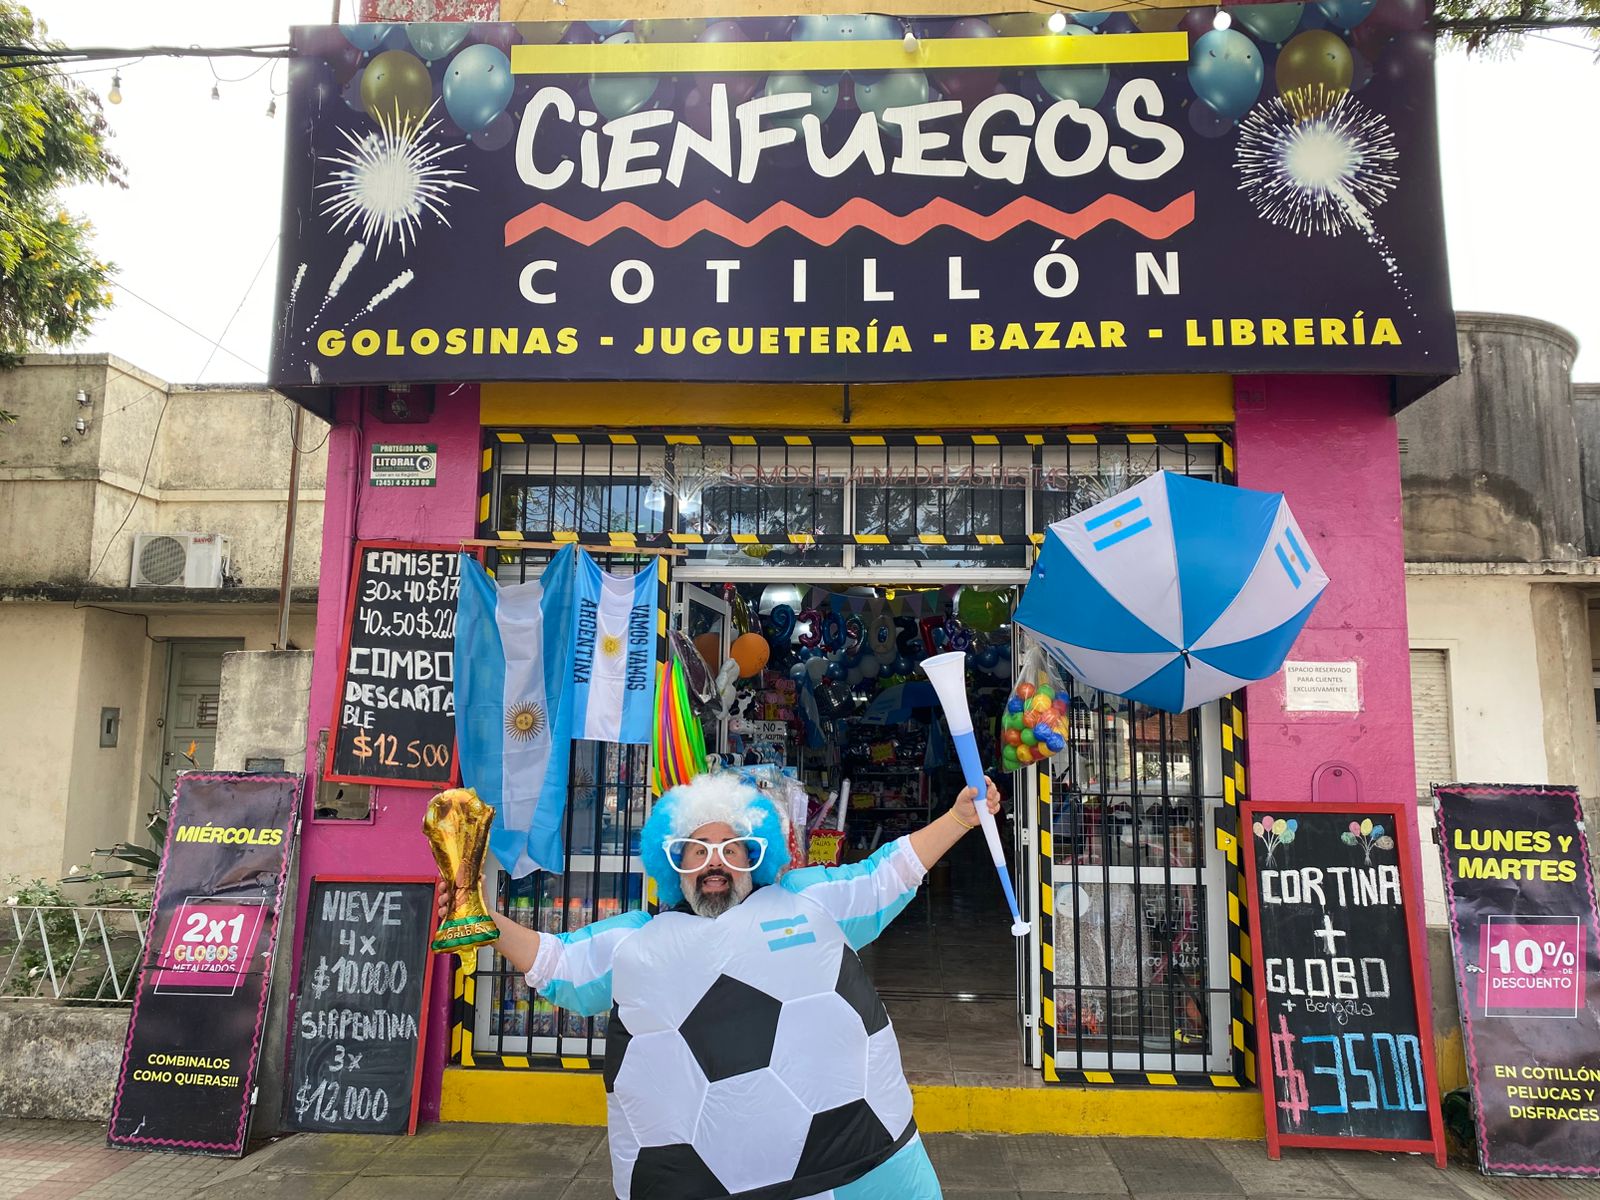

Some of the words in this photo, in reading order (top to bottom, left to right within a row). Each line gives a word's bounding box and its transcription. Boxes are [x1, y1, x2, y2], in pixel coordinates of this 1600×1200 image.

[317, 327, 579, 357] GOLOSINAS
[635, 320, 912, 356] JUGUETERÍA
[970, 320, 1127, 351] BAZAR
[1185, 311, 1403, 347] LIBRERÍA
[376, 458, 414, 466] LITORAL
[726, 464, 811, 484] SOMOS
[845, 465, 908, 486] ALMA
[630, 604, 650, 645] VAMOS
[574, 598, 598, 684] ARGENTINA
[349, 648, 454, 681] COMBO
[627, 650, 648, 691] VAMOS
[343, 705, 376, 729] BLE
[176, 822, 283, 845] MIÉRCOLES
[1454, 829, 1551, 853] LUNES
[1558, 835, 1573, 853] Y
[1459, 857, 1577, 882] MARTES
[1261, 865, 1402, 908] CORTINA
[322, 890, 402, 926] NIEVE
[182, 912, 244, 944] 2x1
[174, 944, 238, 963] GLOBOS
[1490, 939, 1575, 974] 10%
[1265, 957, 1390, 998] GLOBO
[1492, 977, 1572, 989] DESCUENTO
[301, 1008, 418, 1041] SERPENTINA
[147, 1053, 231, 1070] COMBINALOS
[1494, 1064, 1517, 1078] EN
[1521, 1066, 1600, 1082] COTILLÓN
[133, 1069, 172, 1083] COMO
[174, 1072, 240, 1088] QUIERAS!!!
[1507, 1085, 1582, 1101] PELUCAS
[1584, 1088, 1595, 1102] Y
[1509, 1105, 1600, 1122] DISFRACES
